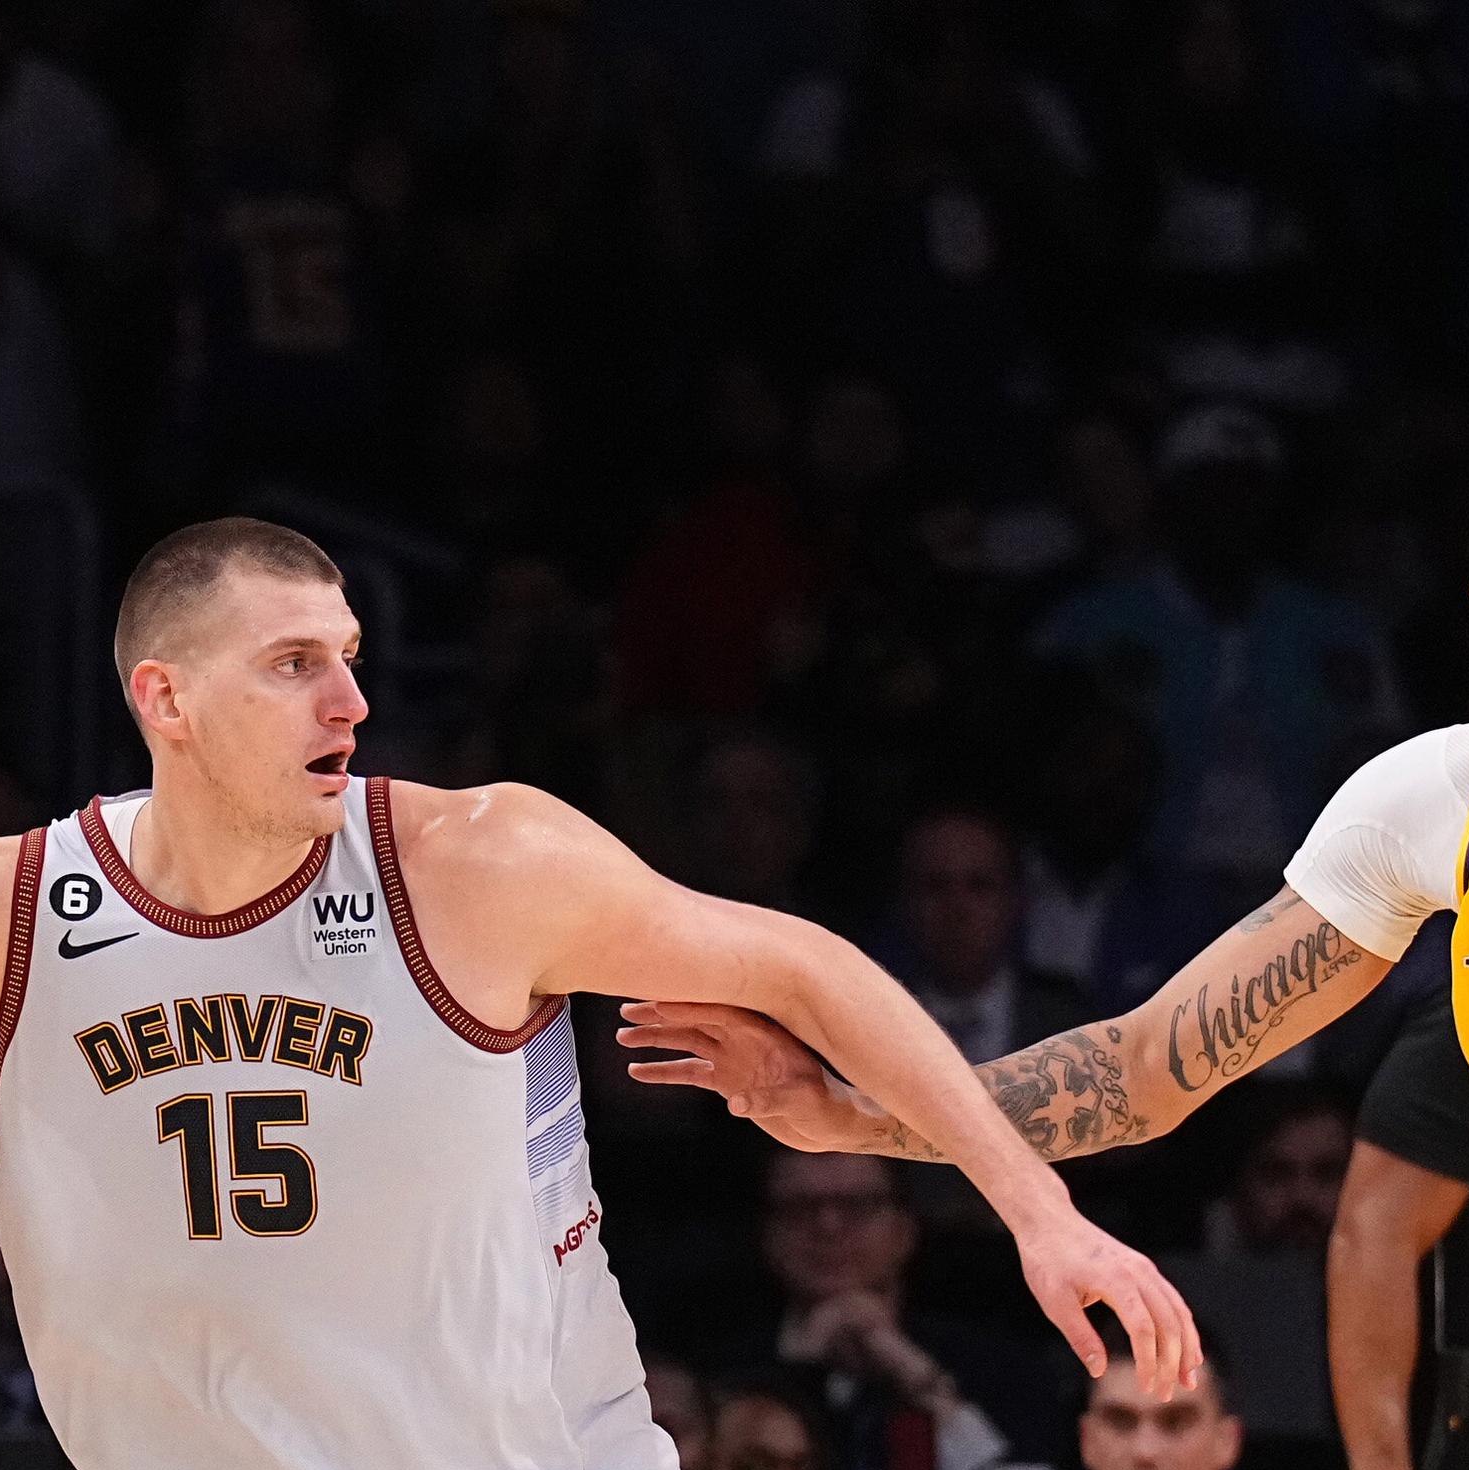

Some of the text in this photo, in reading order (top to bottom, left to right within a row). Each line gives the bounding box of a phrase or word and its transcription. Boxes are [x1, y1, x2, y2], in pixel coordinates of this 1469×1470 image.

[62, 880, 90, 915] 6
[313, 892, 375, 925] WU
[313, 927, 376, 944] Western
[324, 941, 367, 956] Union
[1167, 921, 1341, 1092] Chicago
[74, 993, 373, 1095] DENVER
[157, 1090, 319, 1240] 15
